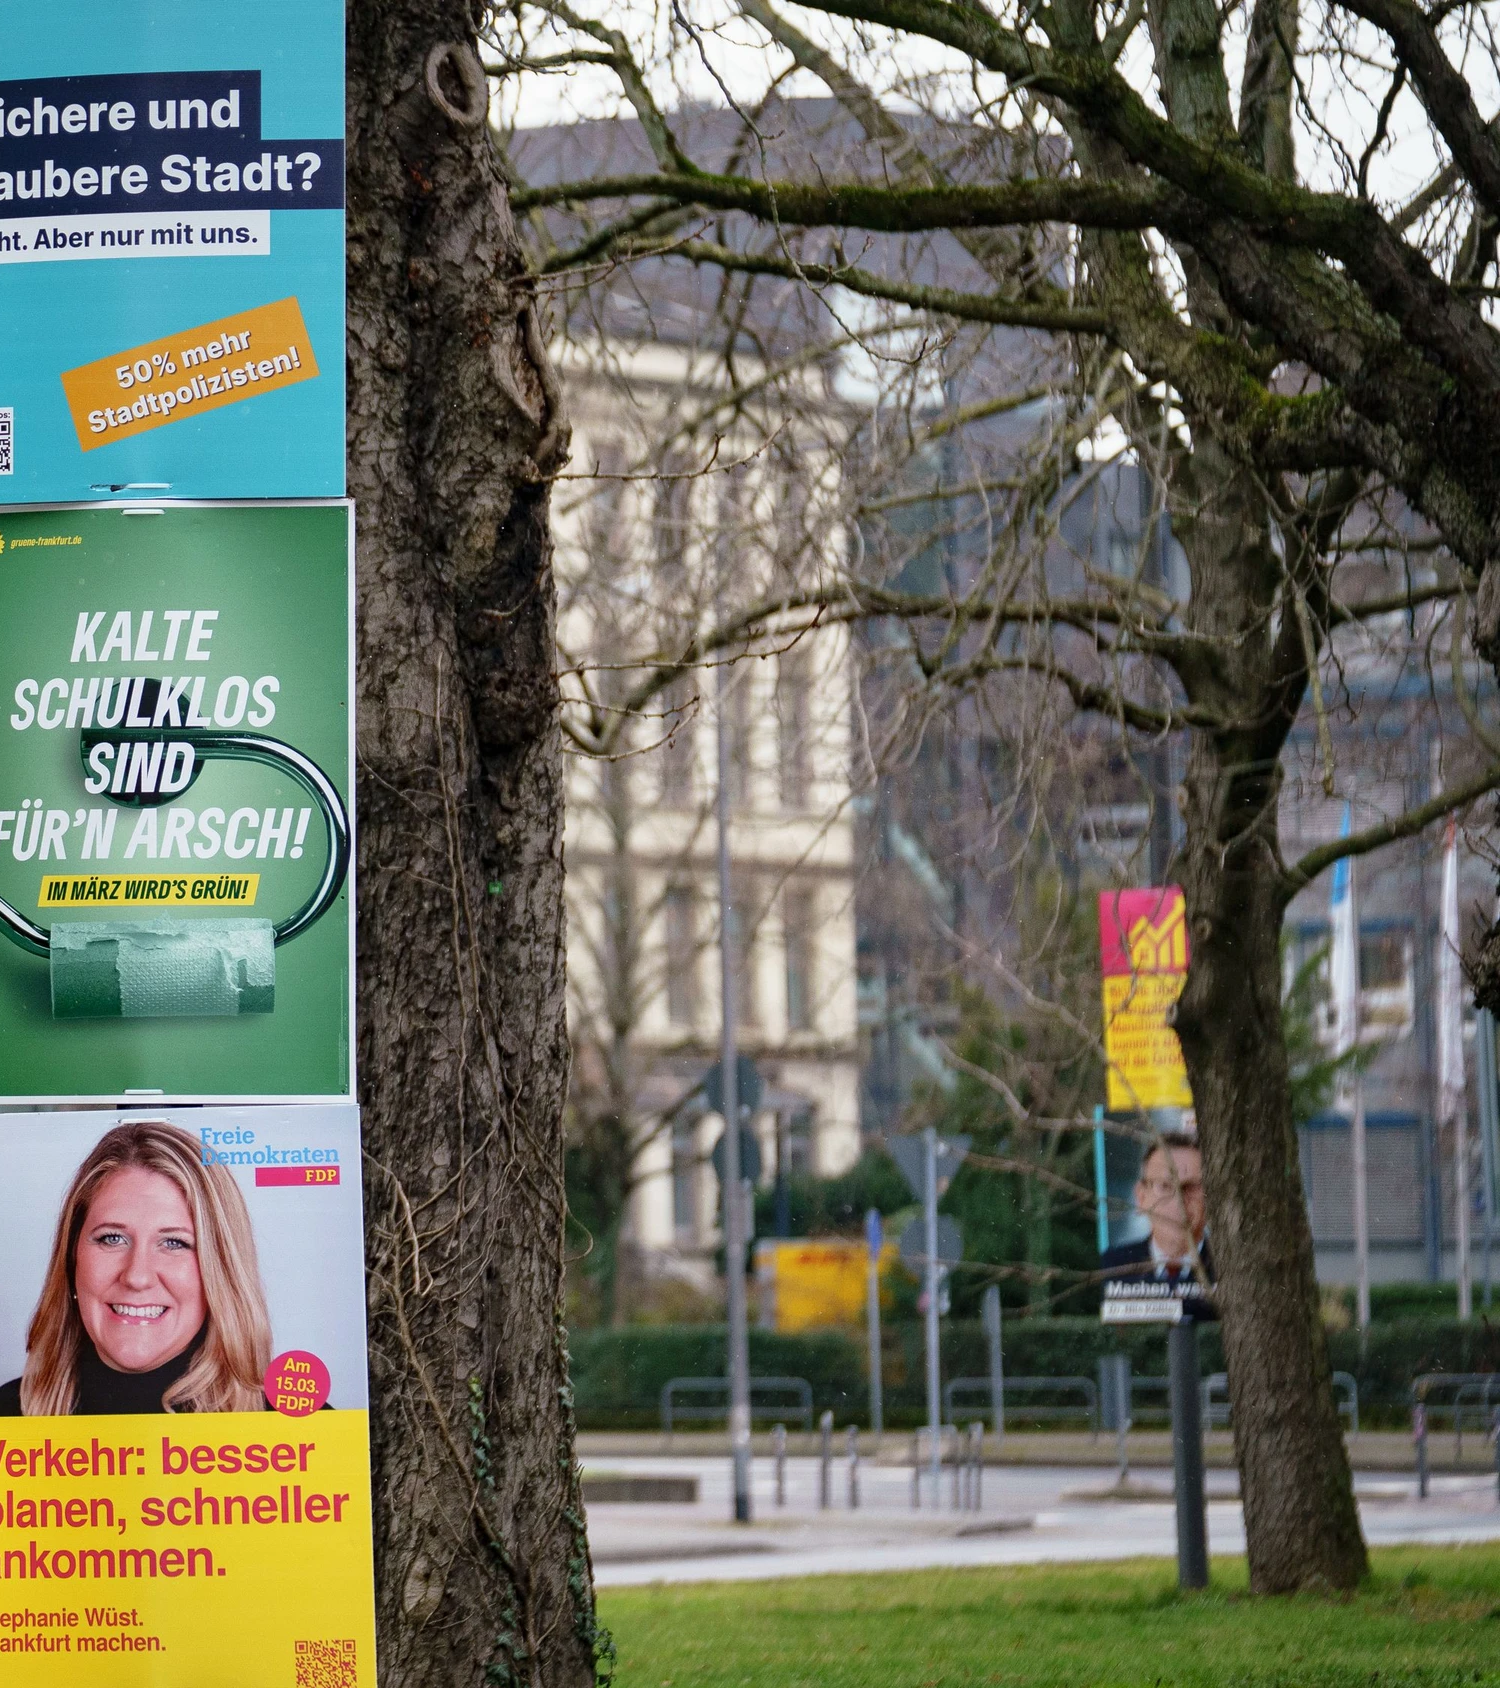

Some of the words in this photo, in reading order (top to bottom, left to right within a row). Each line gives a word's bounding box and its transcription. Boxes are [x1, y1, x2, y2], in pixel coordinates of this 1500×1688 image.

[148, 89, 241, 130] und
[160, 151, 322, 194] Stadt?
[34, 223, 95, 251] Aber
[101, 226, 144, 248] nur
[151, 222, 193, 246] mit
[200, 223, 259, 244] uns.
[116, 351, 177, 389] 50%
[181, 330, 252, 368] mehr
[88, 345, 302, 434] Stadtpolizisten!
[10, 535, 83, 549] gruene-frankfurt.de
[70, 609, 219, 663] KALTE
[10, 675, 280, 731] SCHULKLOS
[85, 741, 196, 795] SIND
[124, 806, 312, 860] ARSCH!
[47, 881, 68, 900] IM
[70, 876, 122, 900] MÄRZ
[191, 875, 250, 900] GRÜN!
[200, 1126, 255, 1146] Freie
[201, 1145, 340, 1166] Demokraten
[305, 1169, 337, 1183] FDP
[283, 1357, 311, 1374] Am
[275, 1375, 320, 1394] 15.03.
[276, 1394, 315, 1413] FDP!
[162, 1437, 315, 1475] besser
[141, 1485, 350, 1527] schneller
[84, 1607, 144, 1627] Wüst.
[77, 1632, 167, 1652] machen.
